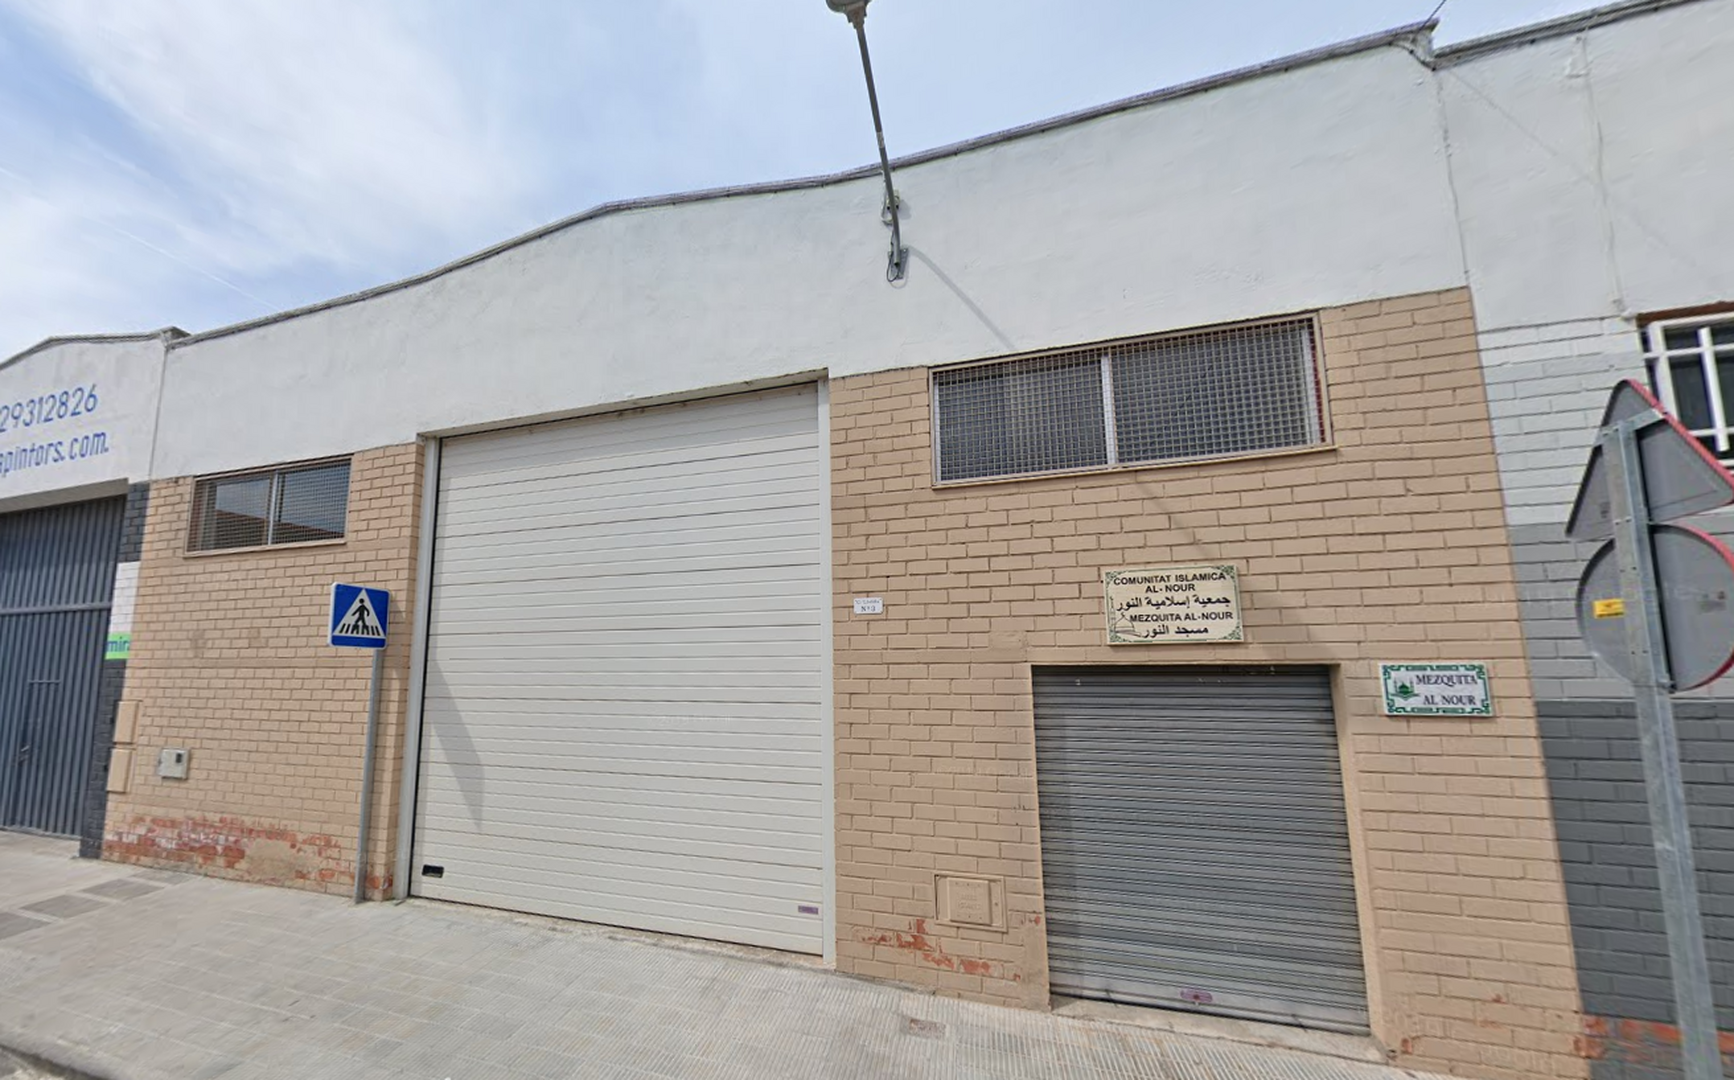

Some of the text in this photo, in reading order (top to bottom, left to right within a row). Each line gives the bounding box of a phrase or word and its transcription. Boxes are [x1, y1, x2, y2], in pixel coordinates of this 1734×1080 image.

[1113, 572, 1227, 586] COMUNITAT ISLAMICA
[1116, 596, 1143, 612] النور
[1193, 594, 1231, 608] جمعية
[1129, 612, 1183, 623] MEZQUITA
[1143, 624, 1209, 639] مسجد النور
[1415, 674, 1478, 688] MEZQUITA
[1422, 694, 1477, 706] AL NOUR
